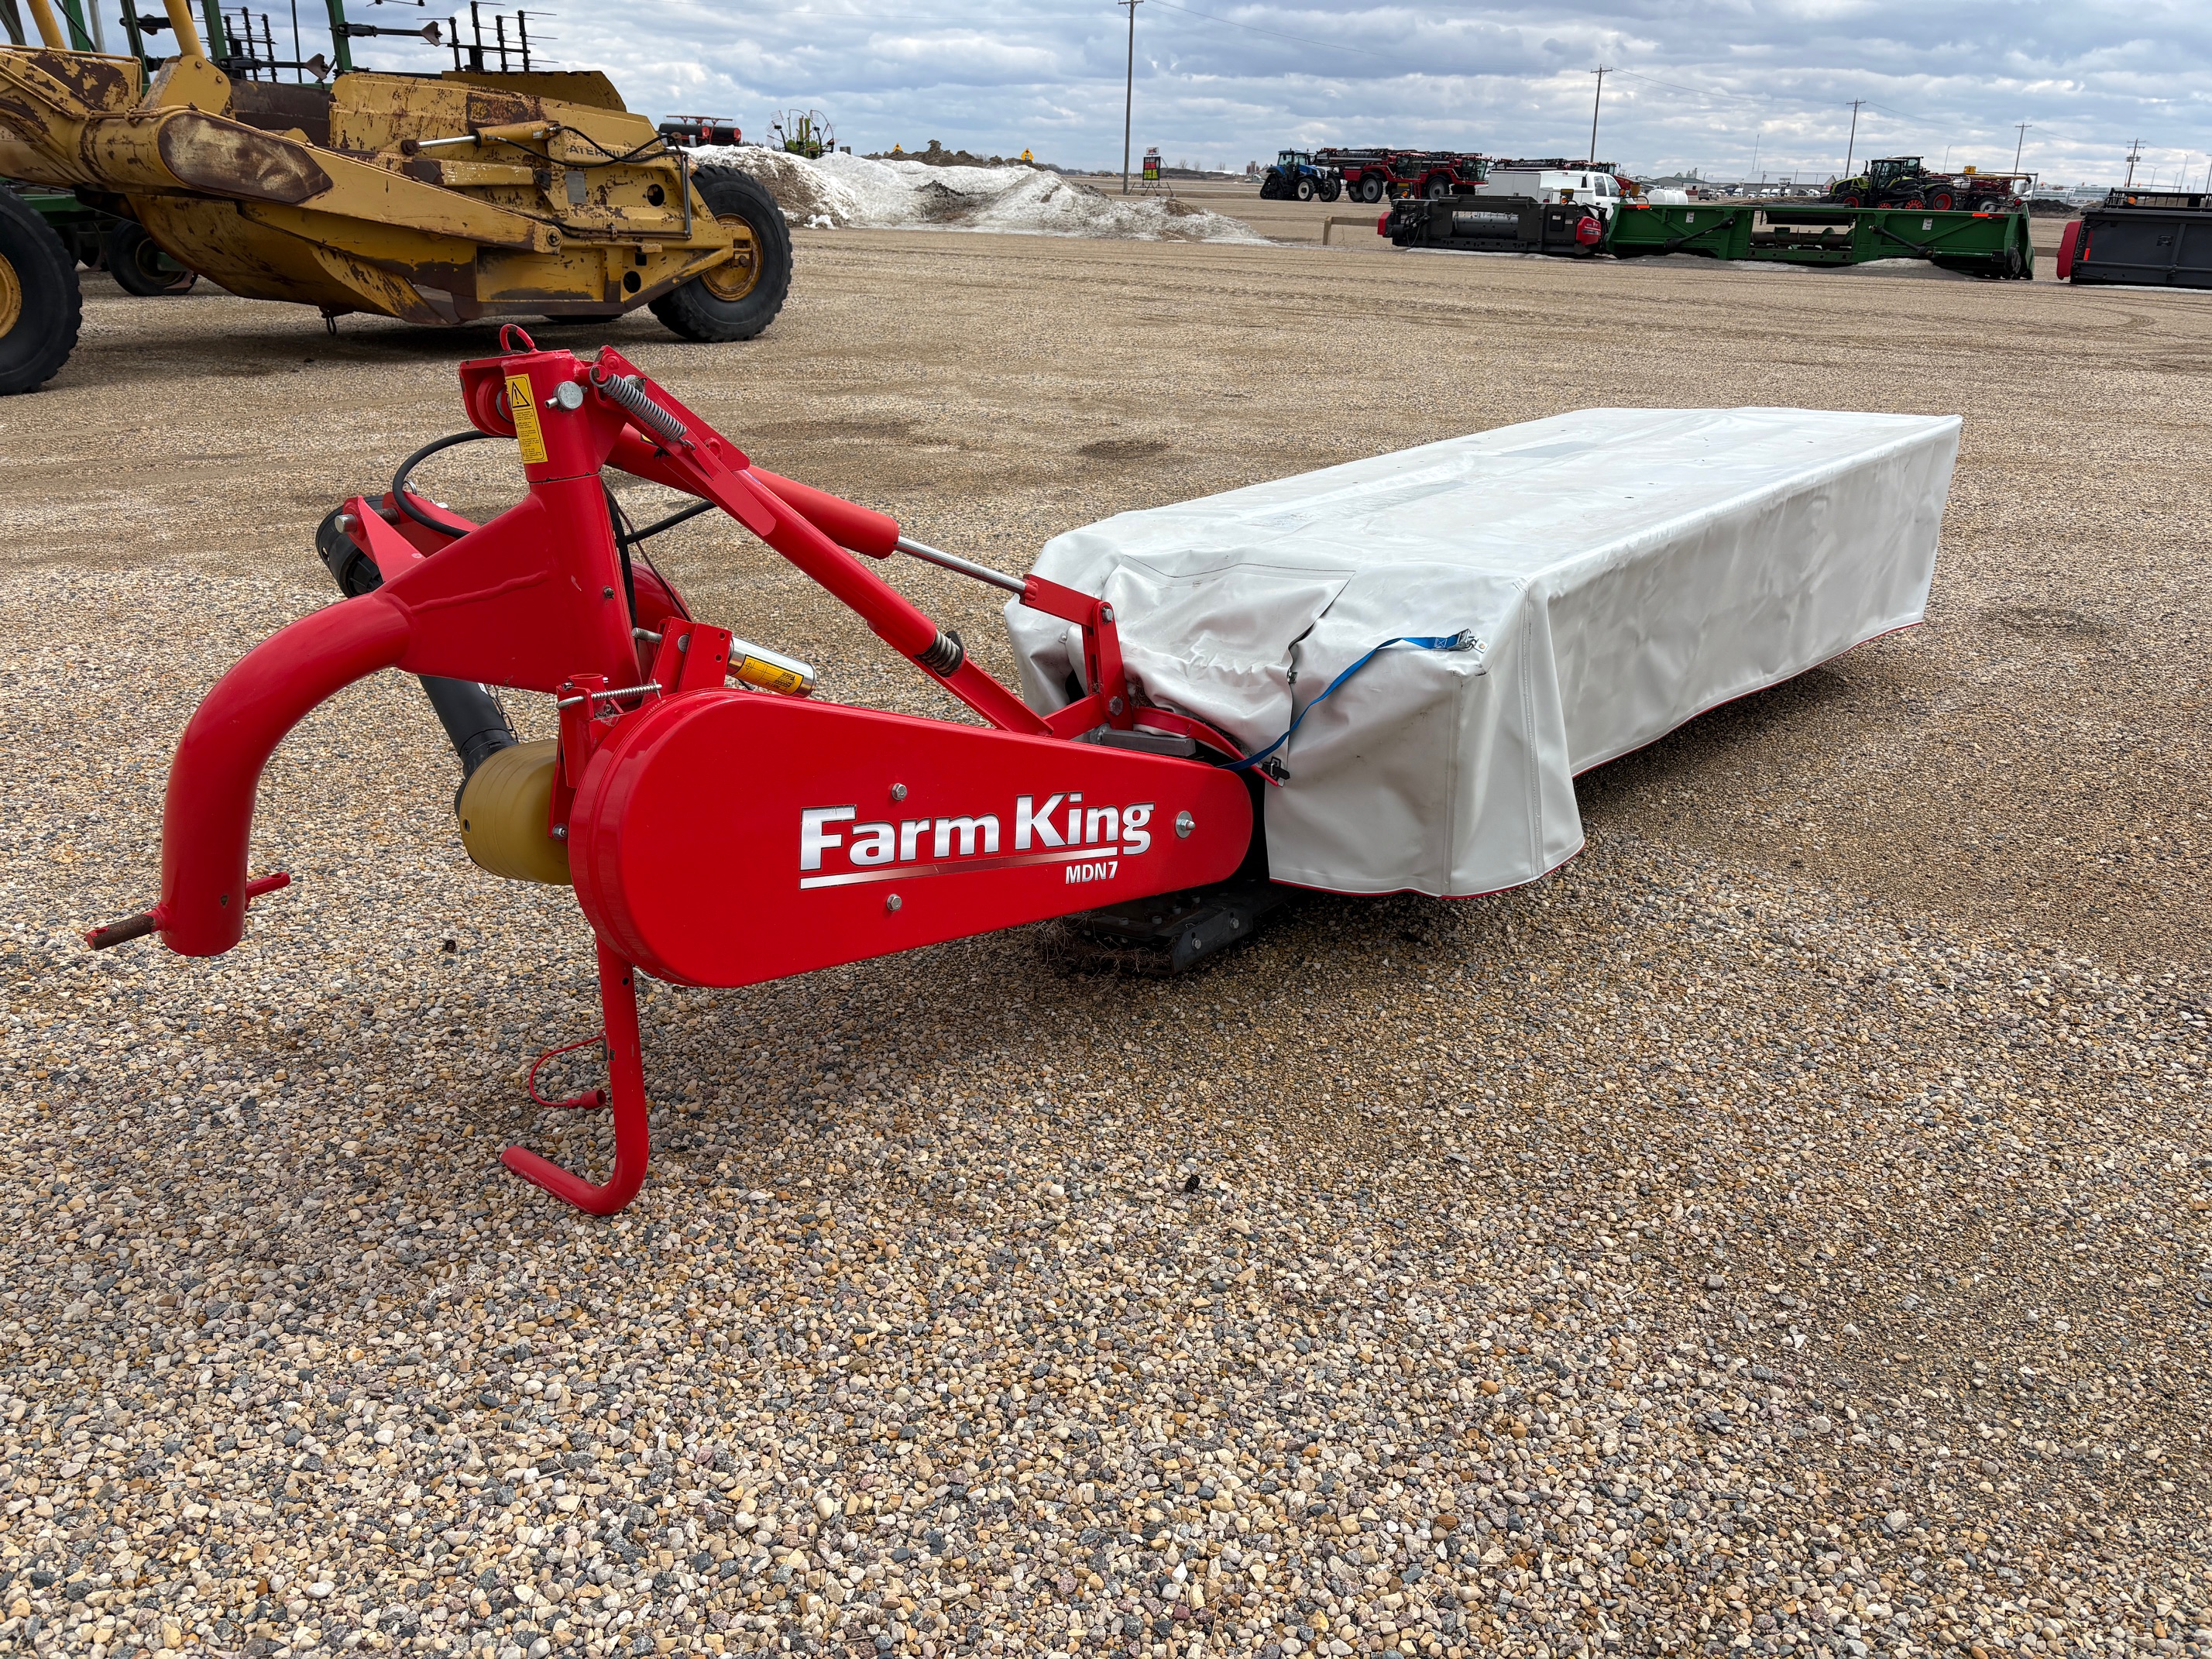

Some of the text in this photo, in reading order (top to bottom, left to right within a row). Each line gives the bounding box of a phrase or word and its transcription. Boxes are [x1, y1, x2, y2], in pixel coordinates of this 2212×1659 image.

[799, 791, 1155, 871] Farm King
[1066, 860, 1118, 884] MDN7
